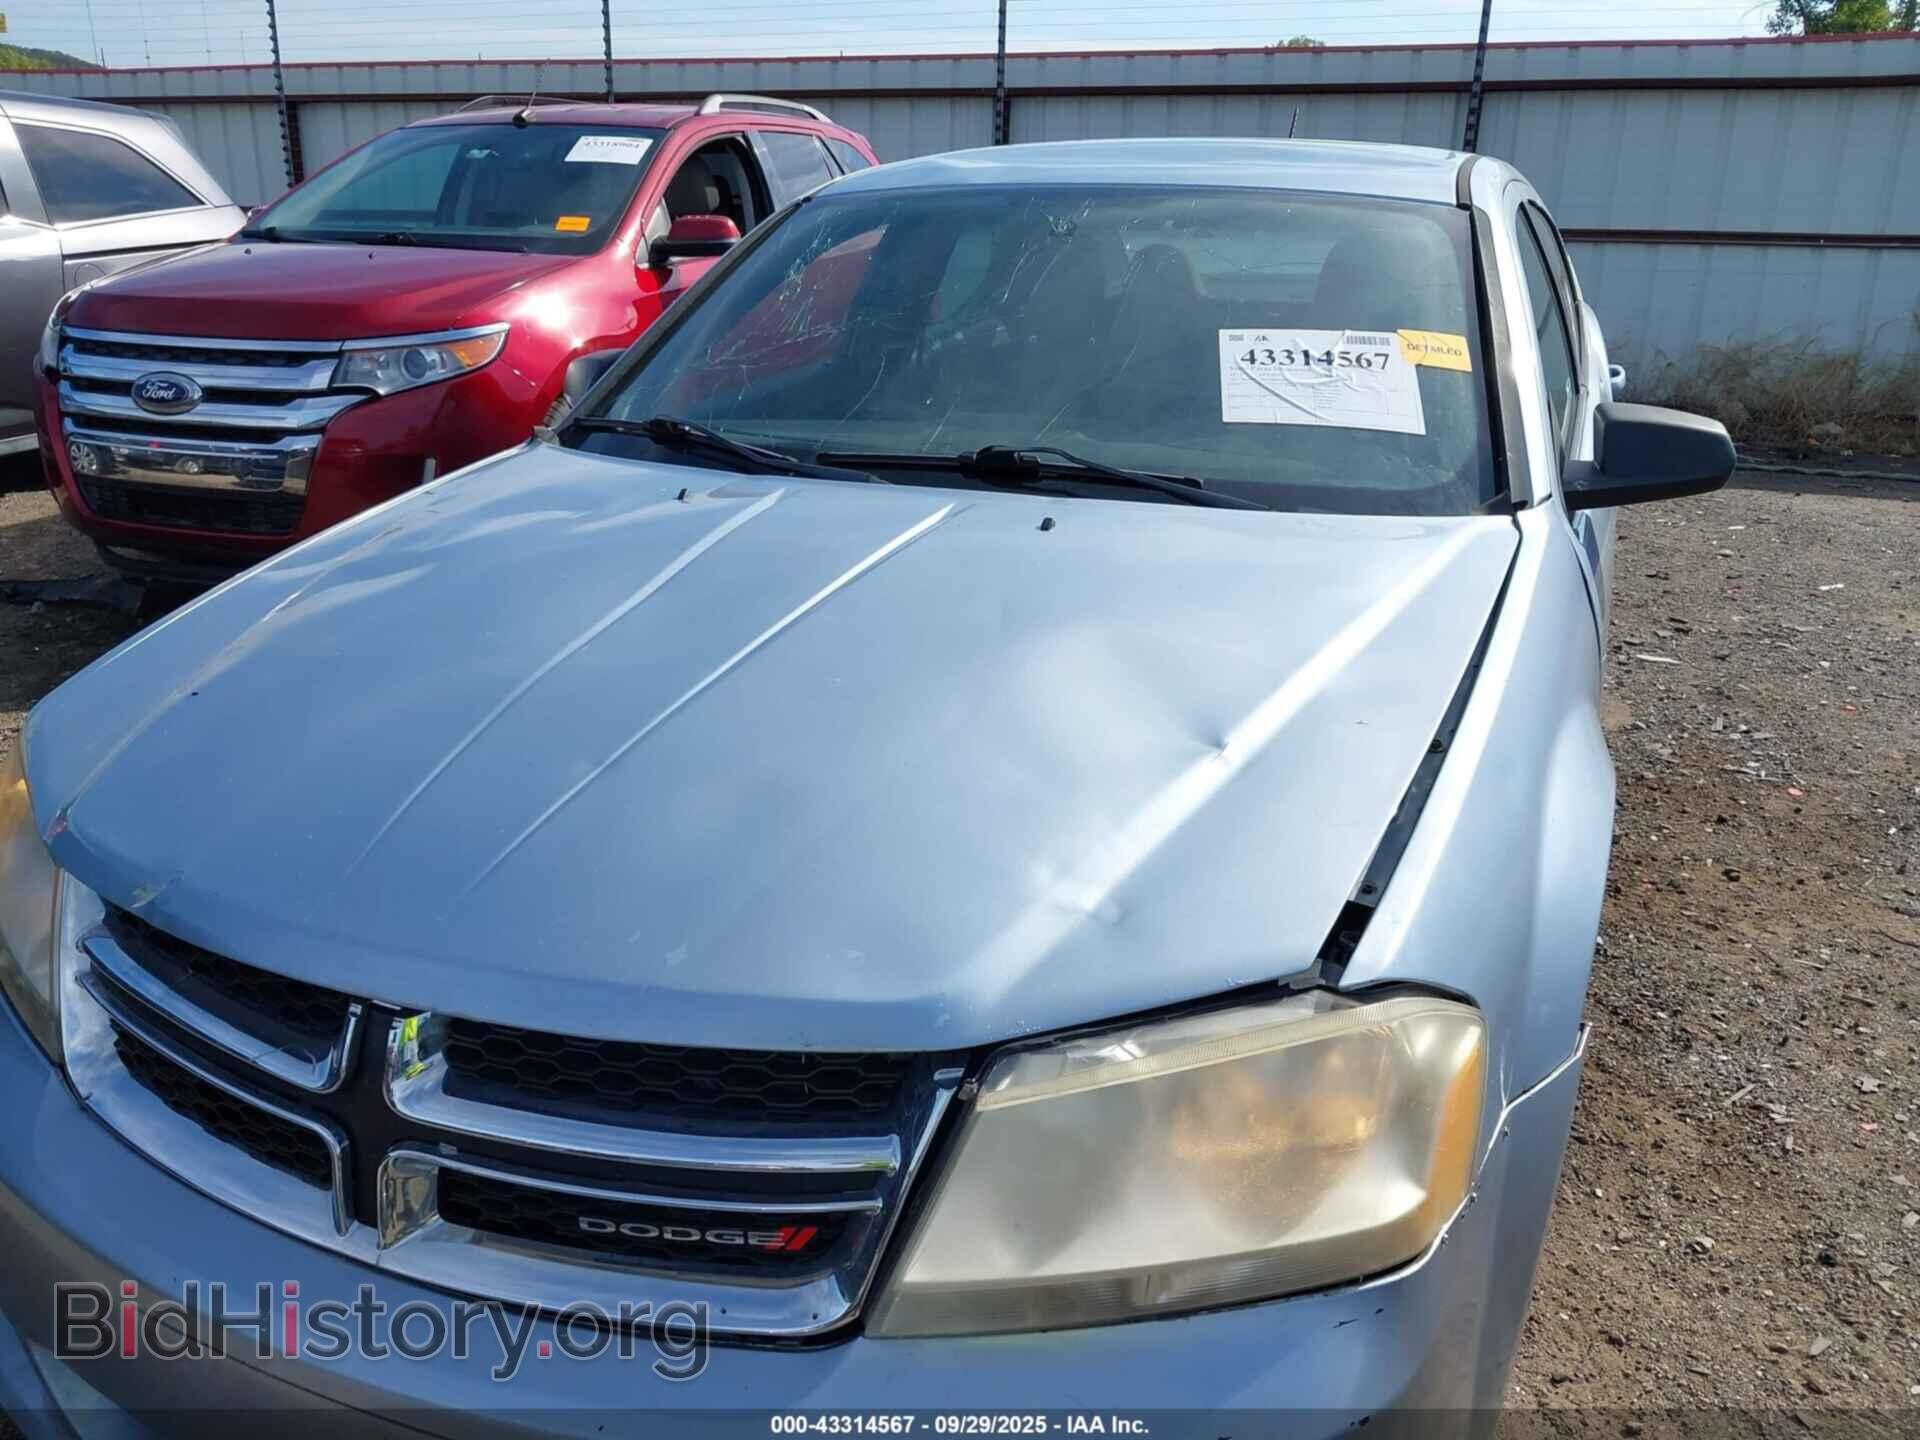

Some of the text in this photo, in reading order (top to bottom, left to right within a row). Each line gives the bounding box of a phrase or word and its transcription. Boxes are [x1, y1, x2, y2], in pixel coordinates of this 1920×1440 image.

[1240, 348, 1390, 370] 43314567
[1406, 342, 1463, 357] DETAILED
[142, 381, 177, 400] Ford
[578, 1216, 786, 1247] DODGE
